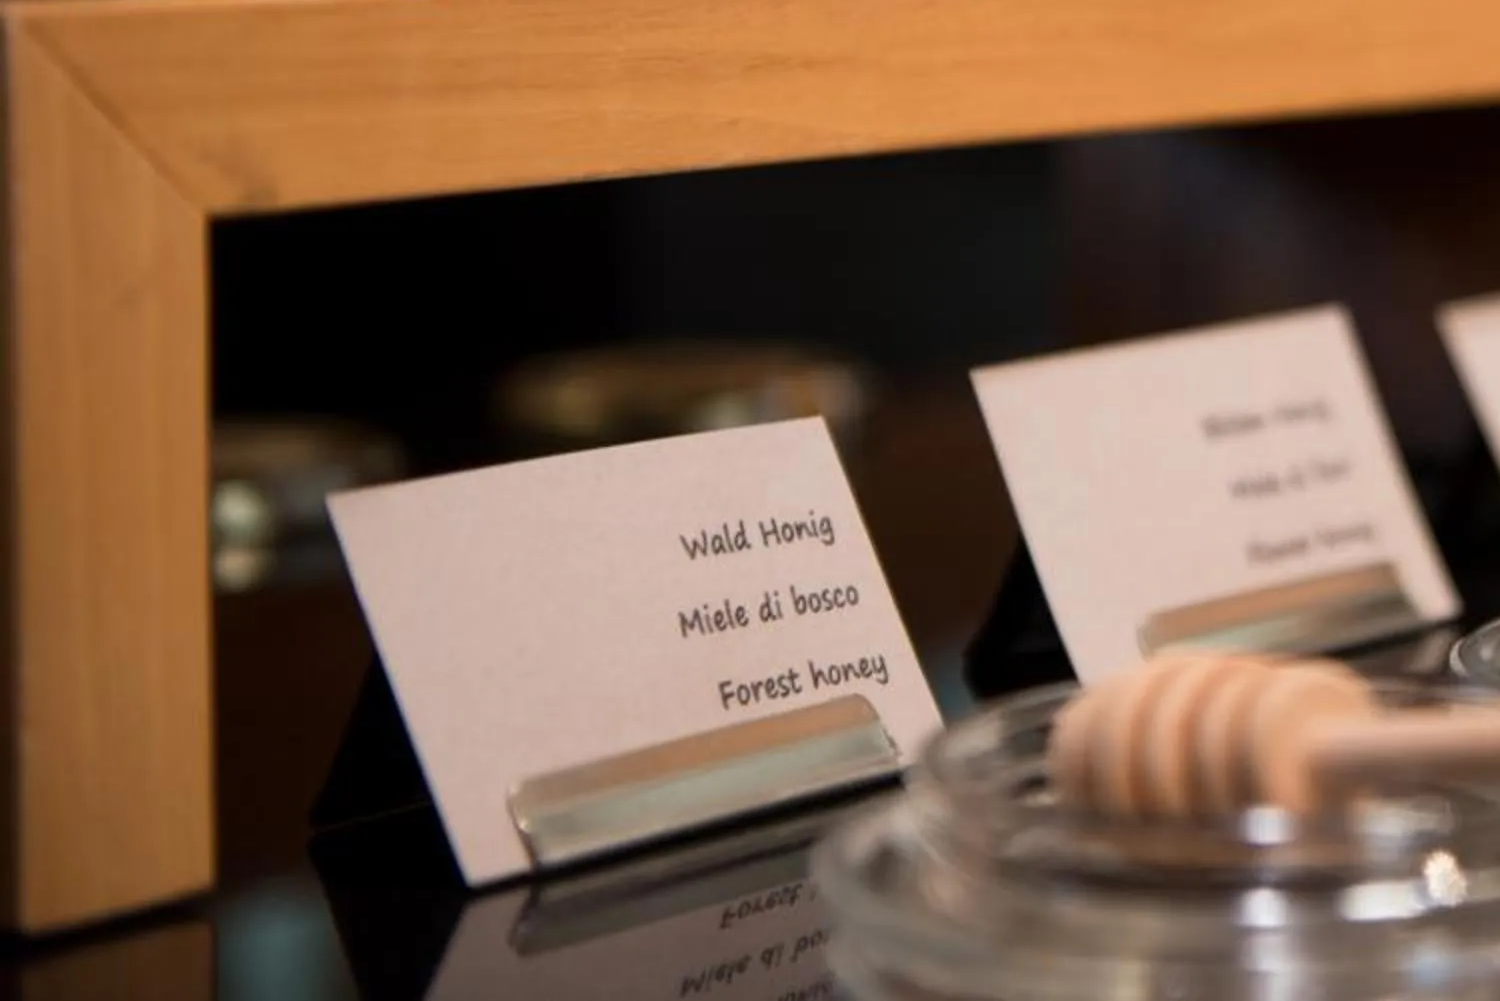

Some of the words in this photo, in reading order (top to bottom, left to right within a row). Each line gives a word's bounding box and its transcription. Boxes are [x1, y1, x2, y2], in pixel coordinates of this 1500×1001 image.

[679, 519, 752, 560] Wald
[758, 509, 837, 547] Honig
[677, 599, 750, 638] Miele
[758, 591, 784, 623] di
[789, 584, 860, 615] bosco
[718, 668, 803, 710] Forest
[808, 654, 890, 691] honey
